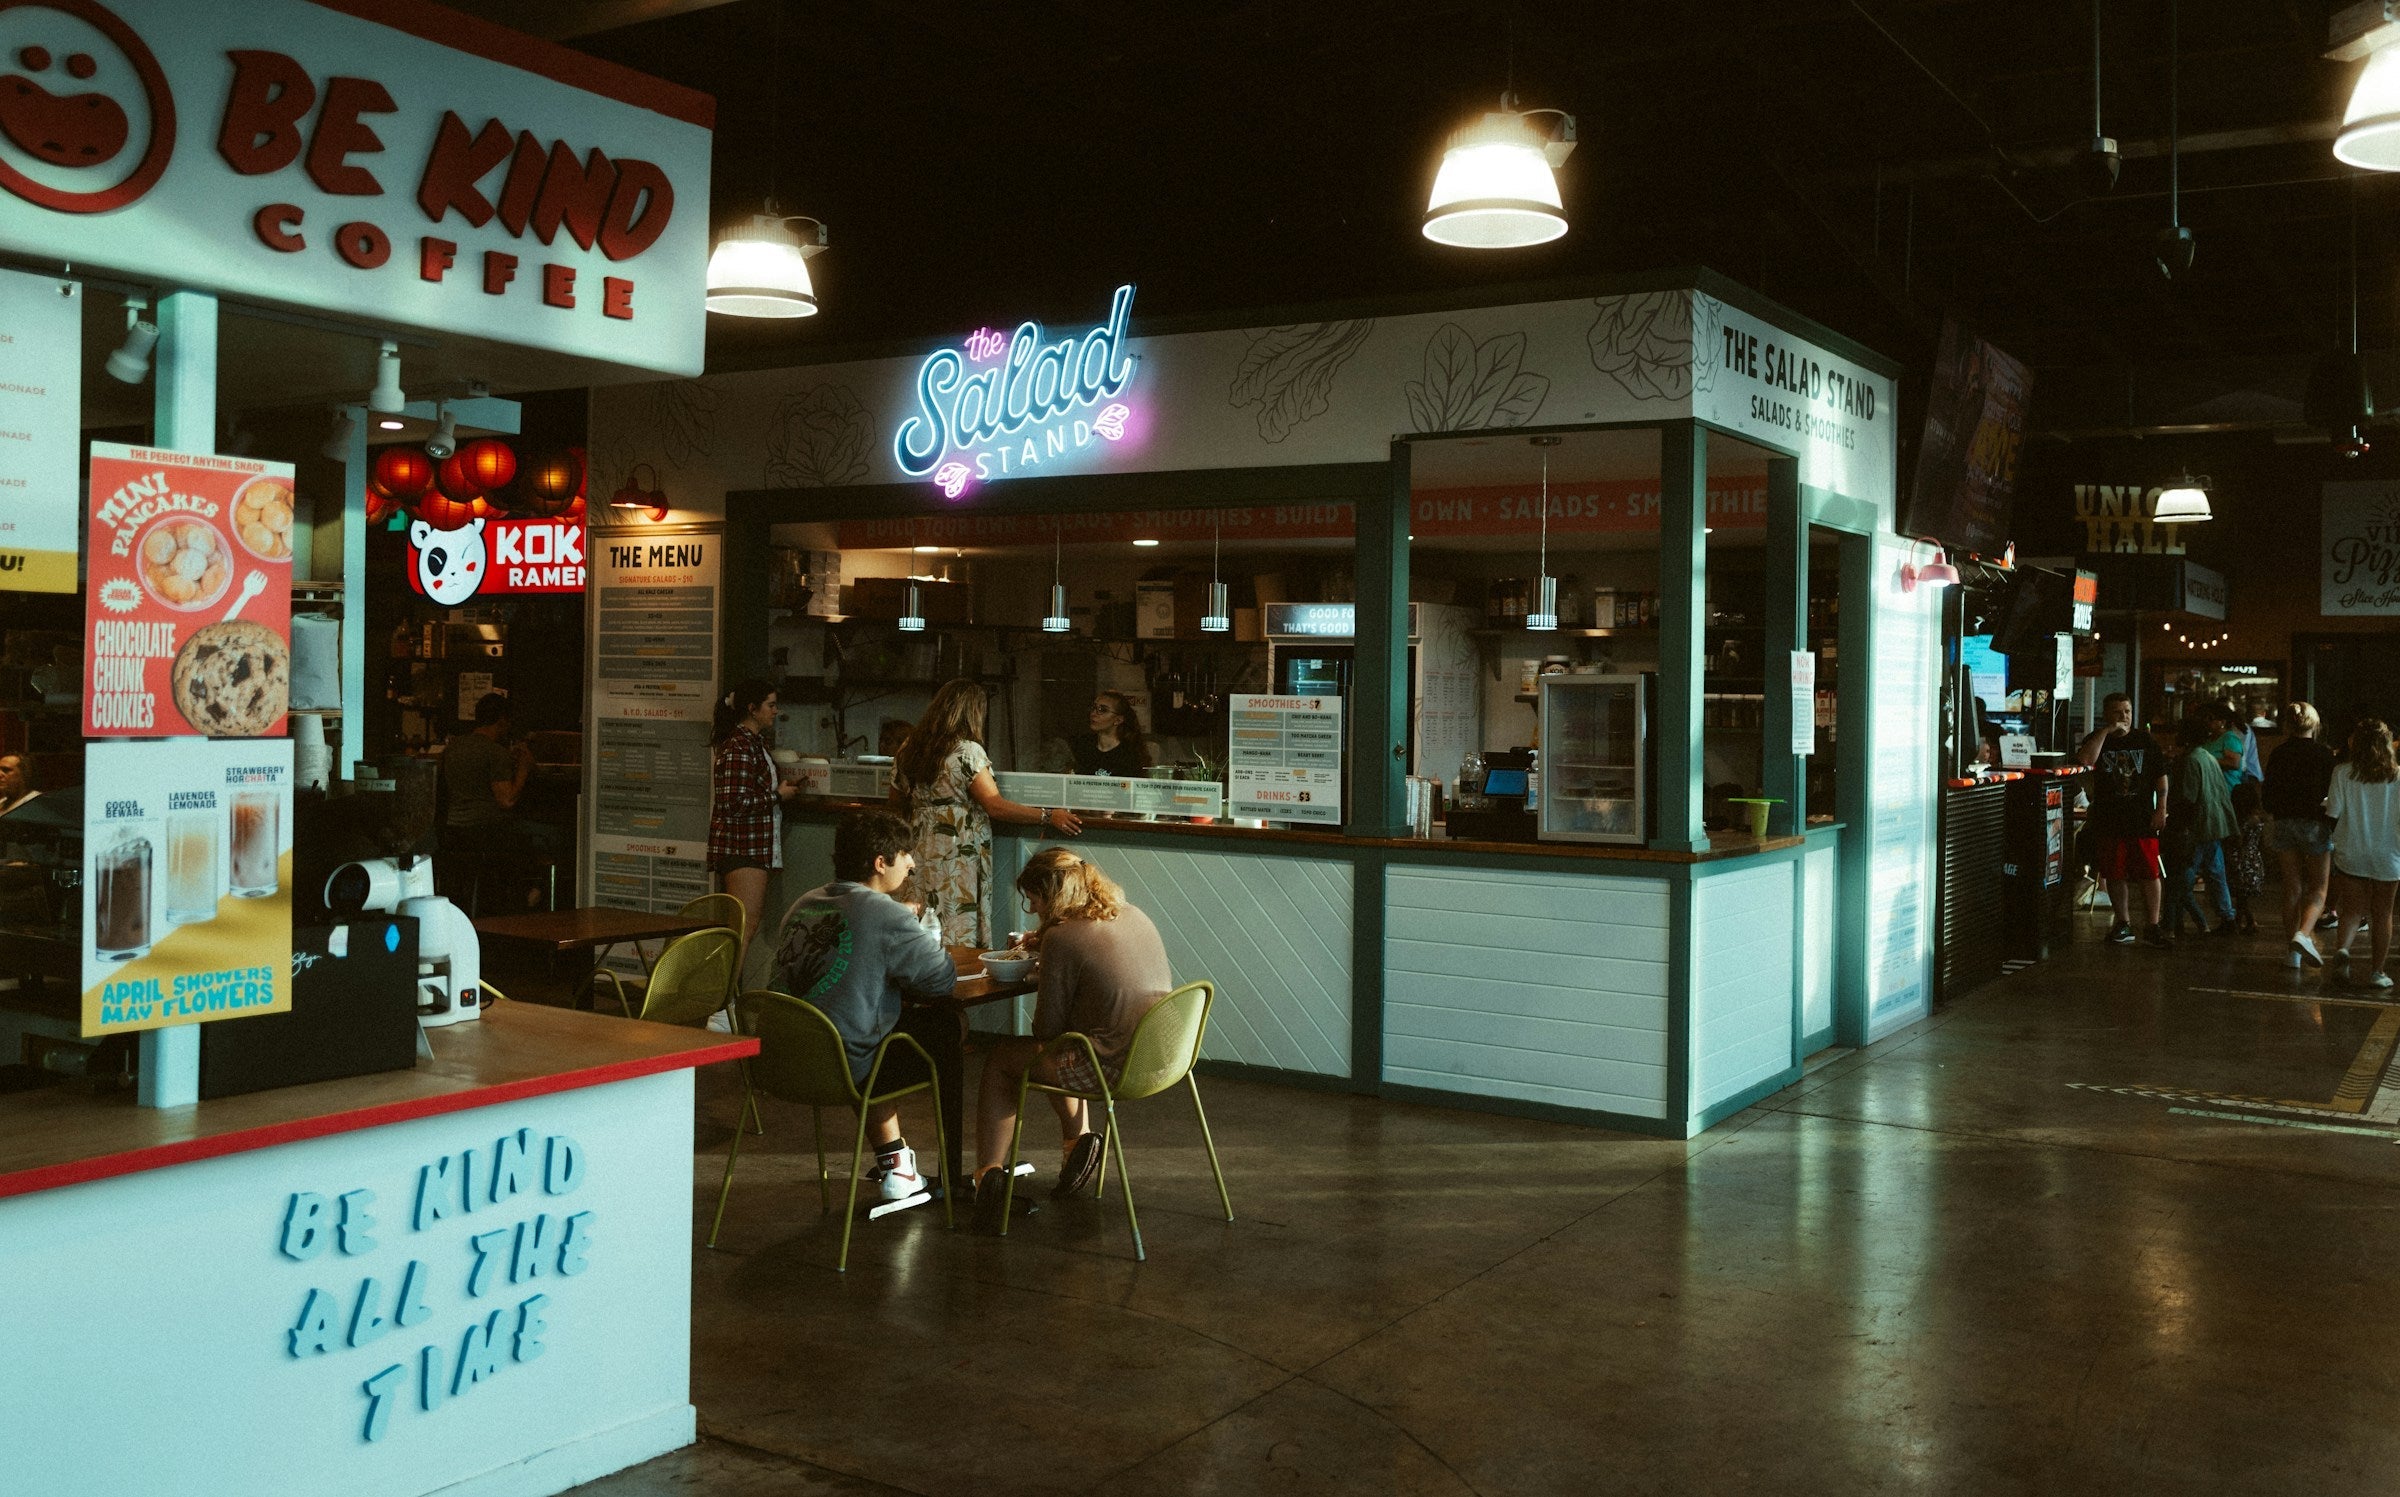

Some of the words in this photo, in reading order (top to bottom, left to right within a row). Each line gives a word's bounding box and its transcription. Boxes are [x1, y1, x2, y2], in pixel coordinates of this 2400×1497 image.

[216, 50, 399, 196] BE
[417, 109, 674, 262] KIND
[253, 203, 634, 320] COFFEE
[964, 326, 1006, 362] the
[894, 284, 1135, 476] Salad
[1723, 325, 1757, 379] THE
[1765, 343, 1821, 400] SALAD
[1827, 369, 1875, 421] STAND
[1751, 394, 1791, 430] SALADS
[1794, 408, 1801, 431] &
[1805, 413, 1855, 451] SMOOTHIES
[130, 449, 148, 460] THE
[150, 450, 190, 464] PERFECT
[193, 456, 232, 469] ANYTIME
[235, 460, 266, 473] SNACK
[976, 420, 1089, 479] STAND
[96, 471, 170, 529] MINI
[1418, 499, 1472, 522] OWN
[1500, 494, 1599, 519] SALADS
[111, 494, 219, 557] PANCAKES
[2086, 519, 2187, 555] HALL
[496, 524, 586, 565] KOK
[610, 546, 642, 568] THE
[649, 544, 703, 568] MENU
[619, 575, 651, 584] SIGNATURE
[652, 575, 676, 583] SALADS
[683, 574, 694, 584] $10
[1283, 623, 1317, 634] THAT'S
[1319, 623, 1348, 634] GOOD
[1309, 608, 1339, 619] GOOD
[94, 620, 177, 658] CHOCOLATE
[93, 656, 146, 693] CHUNK
[92, 693, 155, 729] COOKIES
[644, 709, 668, 718] SALADS
[1248, 699, 1300, 709] SMOOTHIES
[1309, 700, 1320, 709] $7
[226, 766, 284, 776] STRAWBERRY
[226, 774, 277, 784] HORCHAITA
[105, 800, 138, 810] COCOA
[105, 808, 145, 818] BEWARE
[169, 791, 215, 801] LAVENDER
[169, 800, 217, 810] LEMONADE
[1256, 790, 1291, 801] DRINKS
[1299, 791, 1311, 802] $3
[626, 843, 661, 854] SMOOTHIES
[101, 977, 163, 1005] APRIL
[173, 966, 273, 994] SHOWERS
[101, 1005, 153, 1024] MAY
[163, 982, 273, 1017] FLOWERS
[279, 1188, 380, 1262] BE
[412, 1127, 587, 1231] KIND
[289, 1260, 433, 1359] ALL
[467, 1210, 597, 1298] THE
[363, 1293, 550, 1443] TIME
